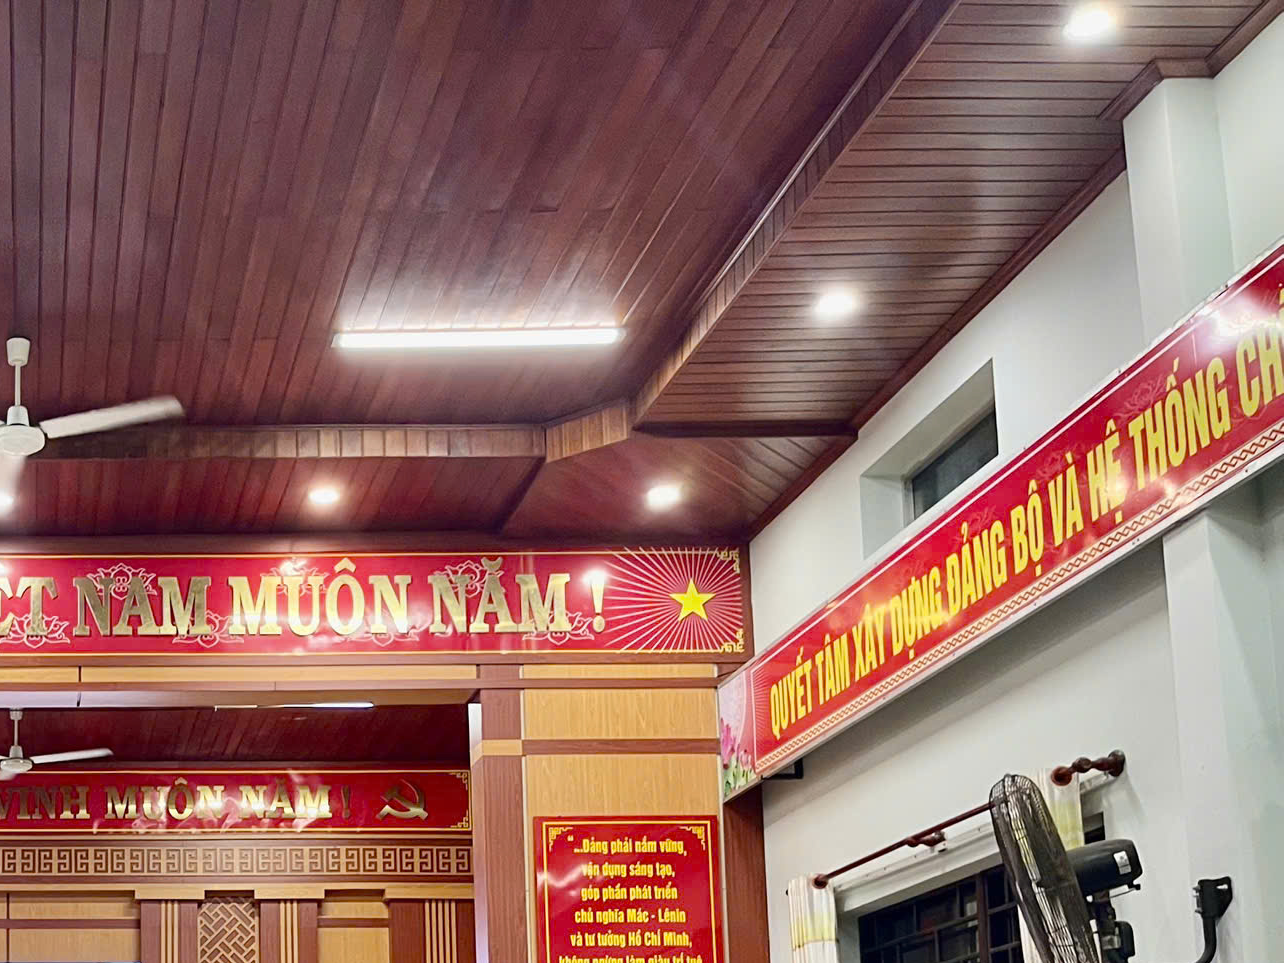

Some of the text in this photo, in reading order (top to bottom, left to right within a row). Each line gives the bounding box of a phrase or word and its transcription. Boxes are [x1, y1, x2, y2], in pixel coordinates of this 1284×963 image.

[770, 288, 1284, 740] QUYẾT TÂM XÂY DỰNG ĐẢNG BỘ VÀ HỆ THỐNG CH
[72, 575, 211, 636] NAM
[227, 558, 413, 636] MUÔN
[427, 556, 571, 635] NĂM
[104, 777, 226, 820] MUÔN
[610, 837, 633, 854] phải
[602, 862, 627, 879] dụng
[629, 860, 653, 878] sáng
[656, 862, 675, 879] tạo,
[581, 884, 600, 901] góp
[629, 885, 652, 901] phát
[575, 907, 686, 925] chủ nghĩa Mác Lênin
[570, 932, 583, 946] và
[644, 929, 661, 946] Chí
[663, 931, 692, 948] Minh,
